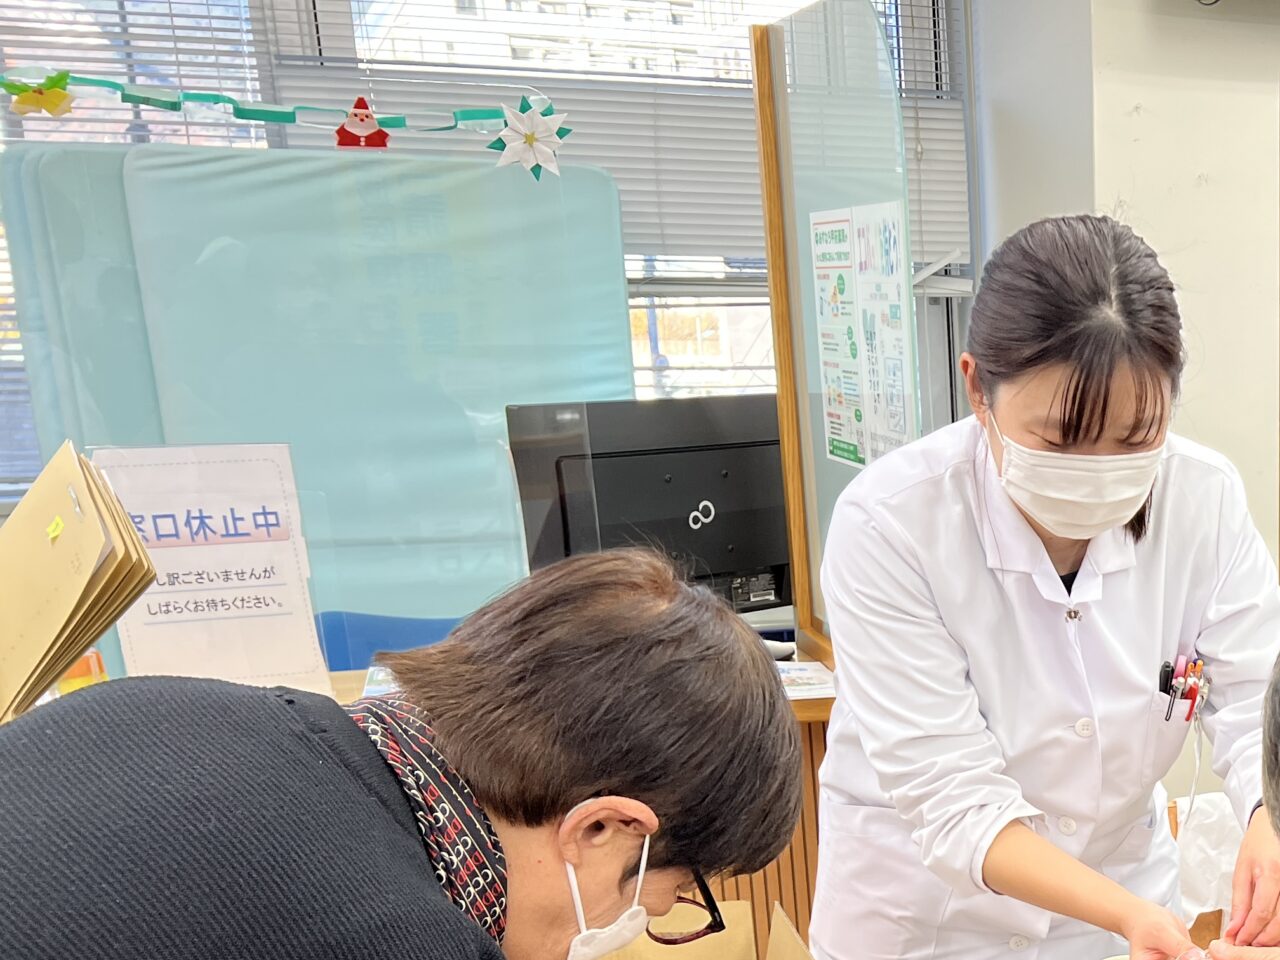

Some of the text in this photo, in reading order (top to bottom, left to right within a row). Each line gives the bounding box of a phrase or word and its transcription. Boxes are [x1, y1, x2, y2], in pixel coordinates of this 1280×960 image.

[146, 595, 284, 616] しばらくお待ちください。
